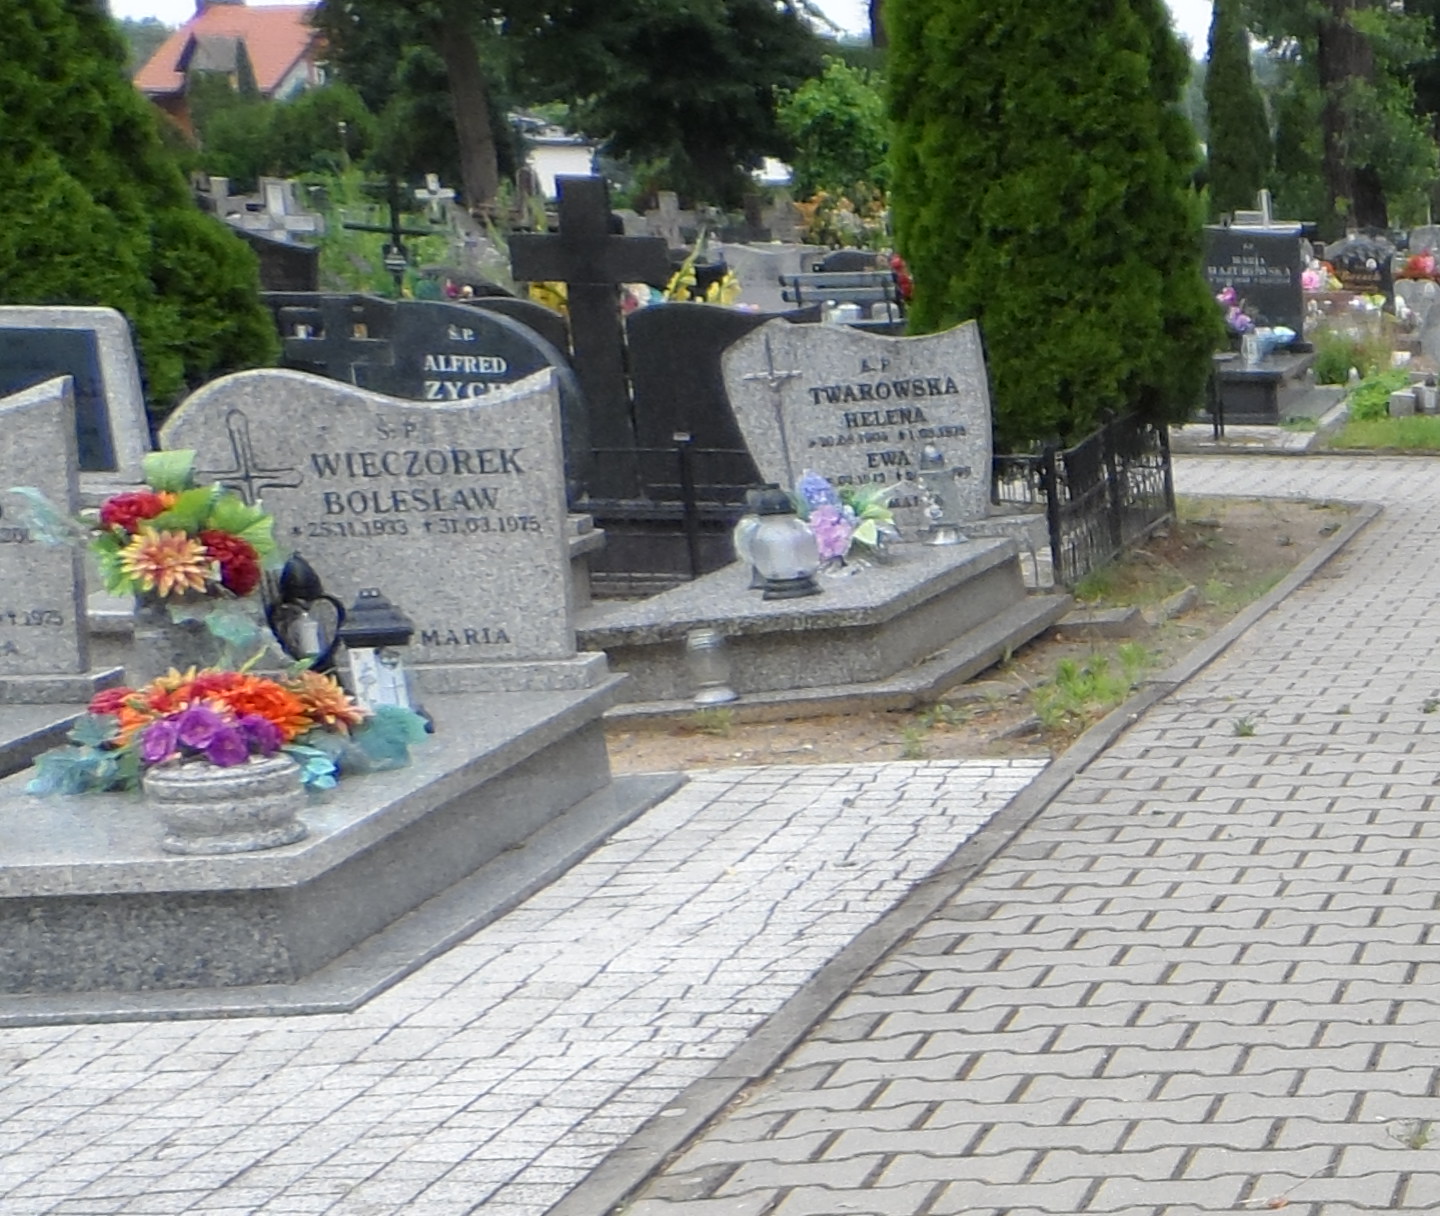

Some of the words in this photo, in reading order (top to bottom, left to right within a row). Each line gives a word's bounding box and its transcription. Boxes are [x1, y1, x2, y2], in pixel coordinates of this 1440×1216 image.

[424, 354, 508, 374] ALFRED
[808, 376, 960, 406] TWAROWSKA
[843, 406, 928, 429] HELENA
[311, 447, 527, 479] WIECZOREK
[867, 450, 912, 468] EWA
[421, 627, 511, 647] MARIA
